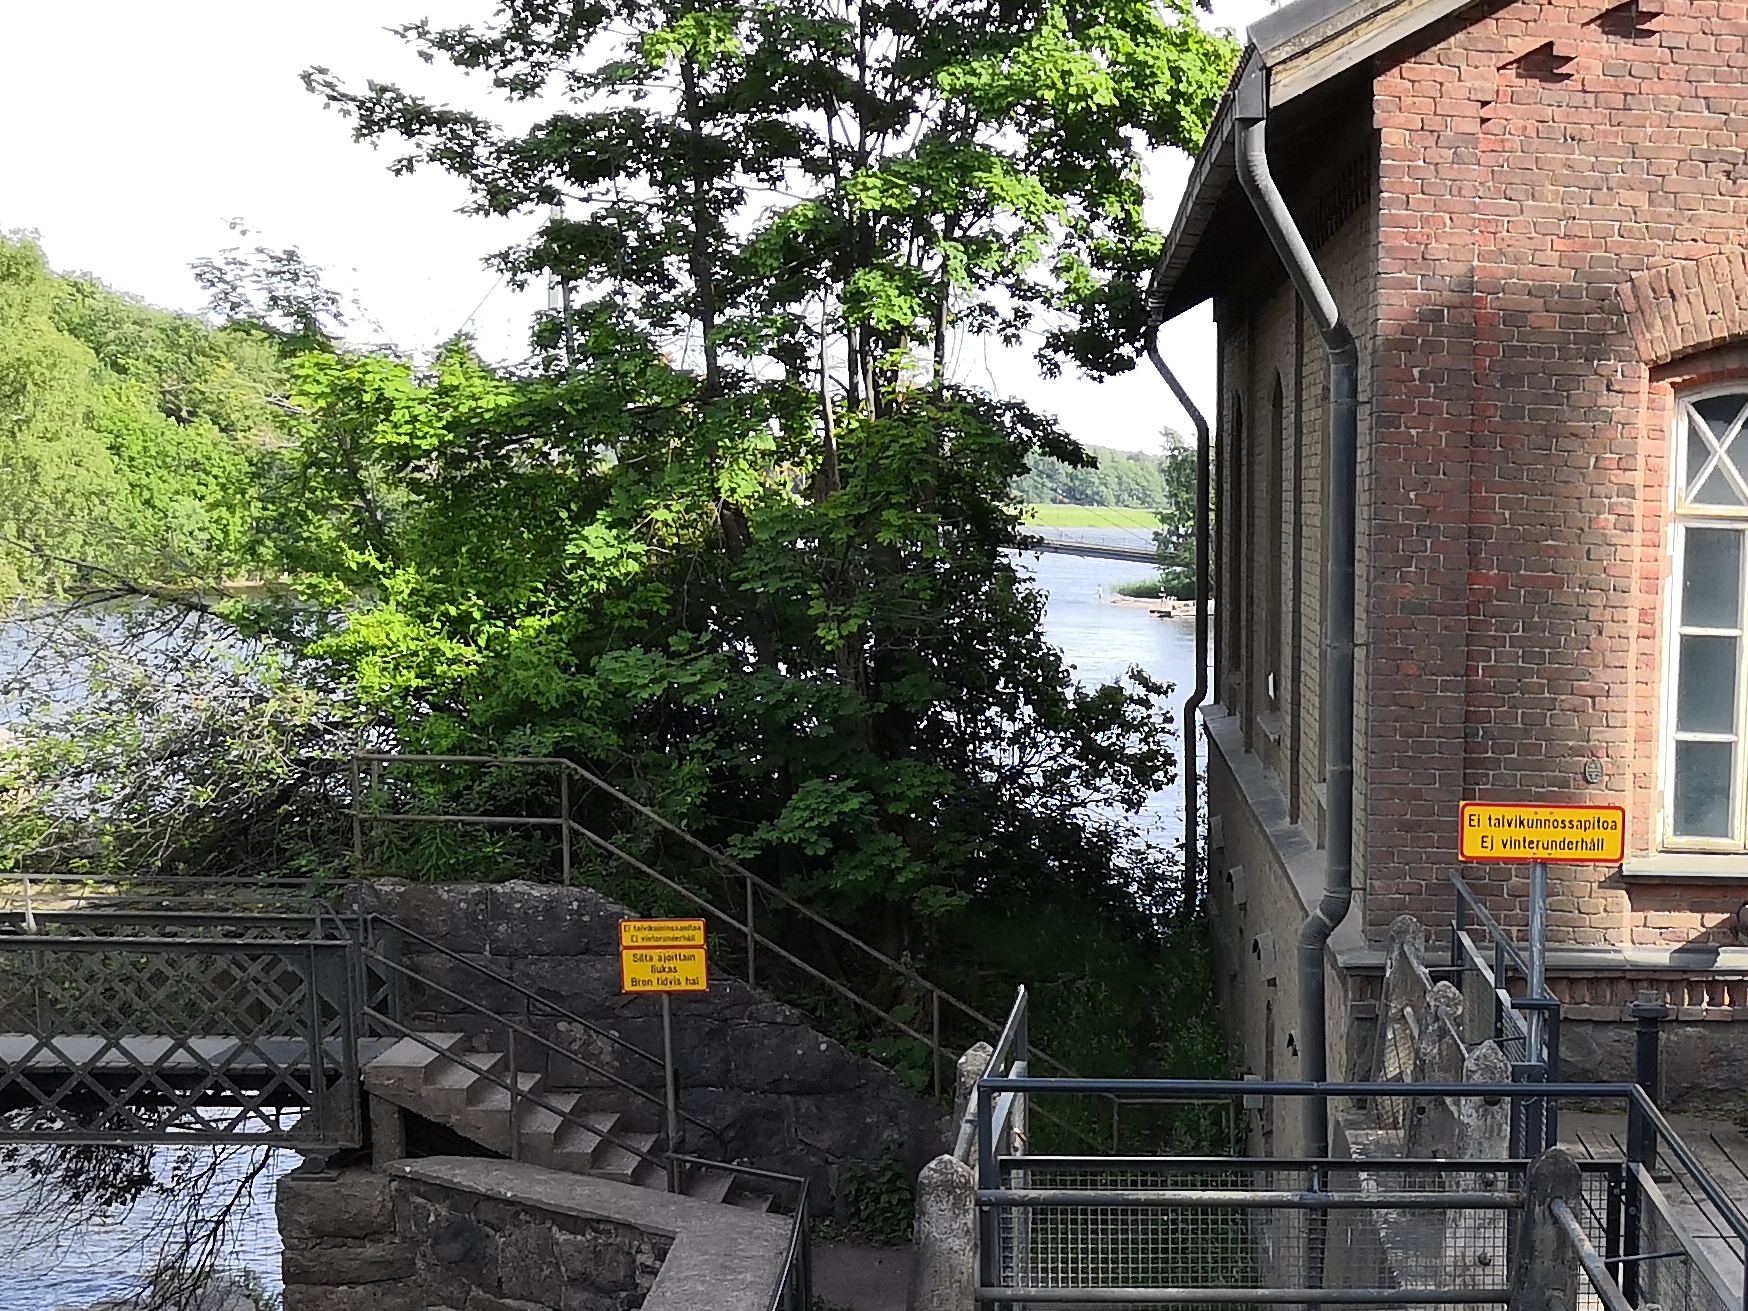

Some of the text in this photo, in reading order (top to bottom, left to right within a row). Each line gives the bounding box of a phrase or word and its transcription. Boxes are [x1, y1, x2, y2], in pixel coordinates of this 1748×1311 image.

[1468, 814, 1617, 832] Ei talvikunnossapitoa
[1480, 836, 1604, 851] Ej vinterunderhåll
[632, 953, 695, 963] Silta ajoittain
[651, 965, 678, 973] liukas
[631, 977, 699, 986] Bron tidvis hal
